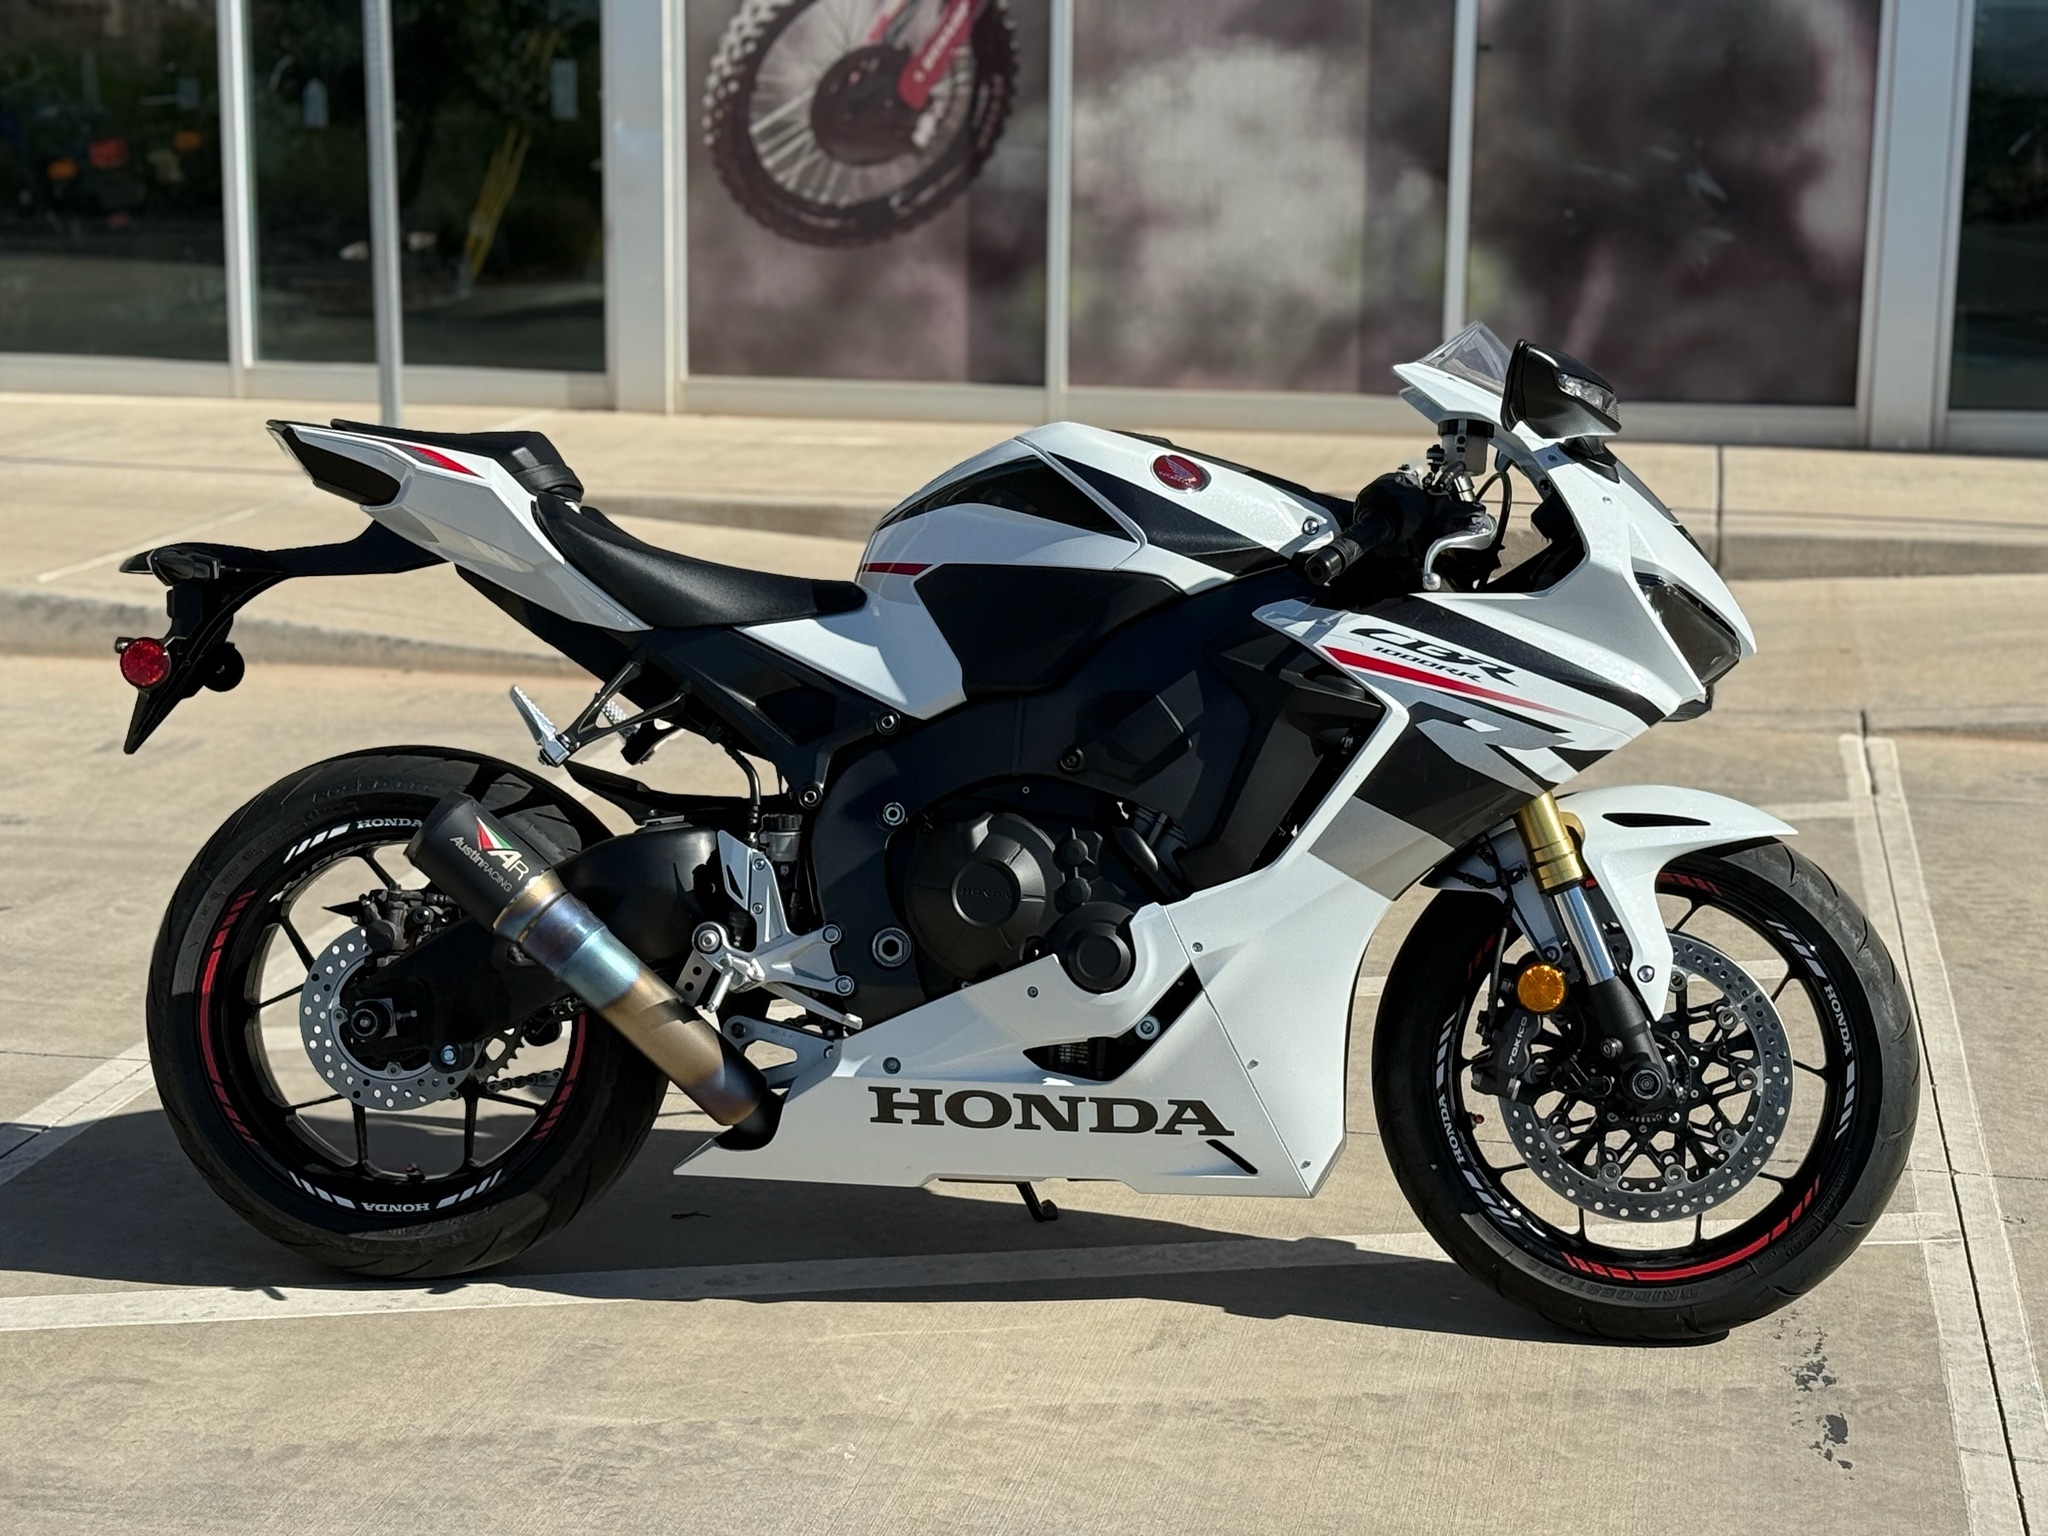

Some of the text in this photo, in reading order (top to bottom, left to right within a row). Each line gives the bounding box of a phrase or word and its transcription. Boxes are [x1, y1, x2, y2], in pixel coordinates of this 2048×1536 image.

[1350, 628, 1519, 687] CBR
[1372, 646, 1482, 683] 1000RR
[356, 817, 423, 830] HONDA
[1508, 1016, 1527, 1066] TOKICO
[1823, 983, 1853, 1057] HONDA
[867, 1085, 1236, 1137] HONDA
[1438, 1092, 1466, 1165] HONDA
[361, 1202, 430, 1213] HONDA
